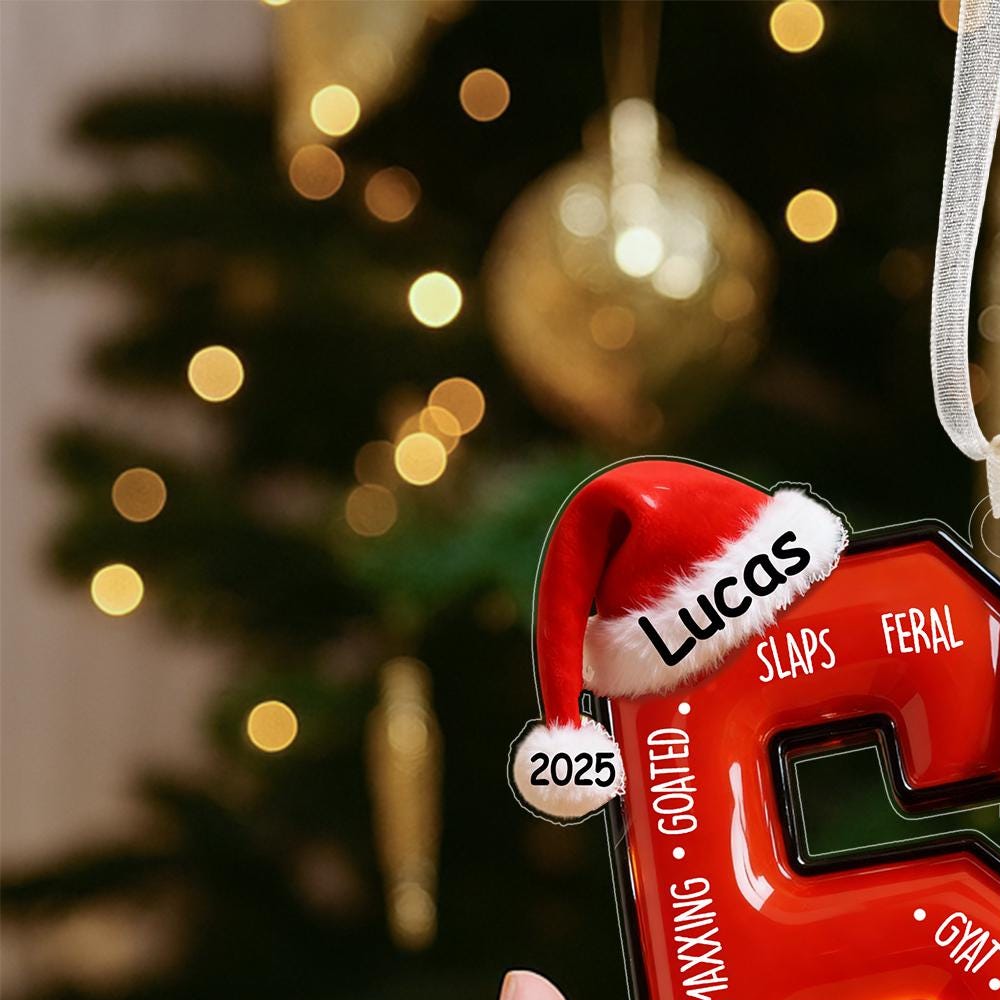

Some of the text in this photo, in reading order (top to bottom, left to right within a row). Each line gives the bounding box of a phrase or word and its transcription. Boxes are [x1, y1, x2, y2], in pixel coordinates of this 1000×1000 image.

[638, 530, 811, 667] Lucas
[756, 604, 964, 683] SLAPS FERAL
[529, 752, 616, 788] 2025
[646, 727, 698, 836] GOATED
